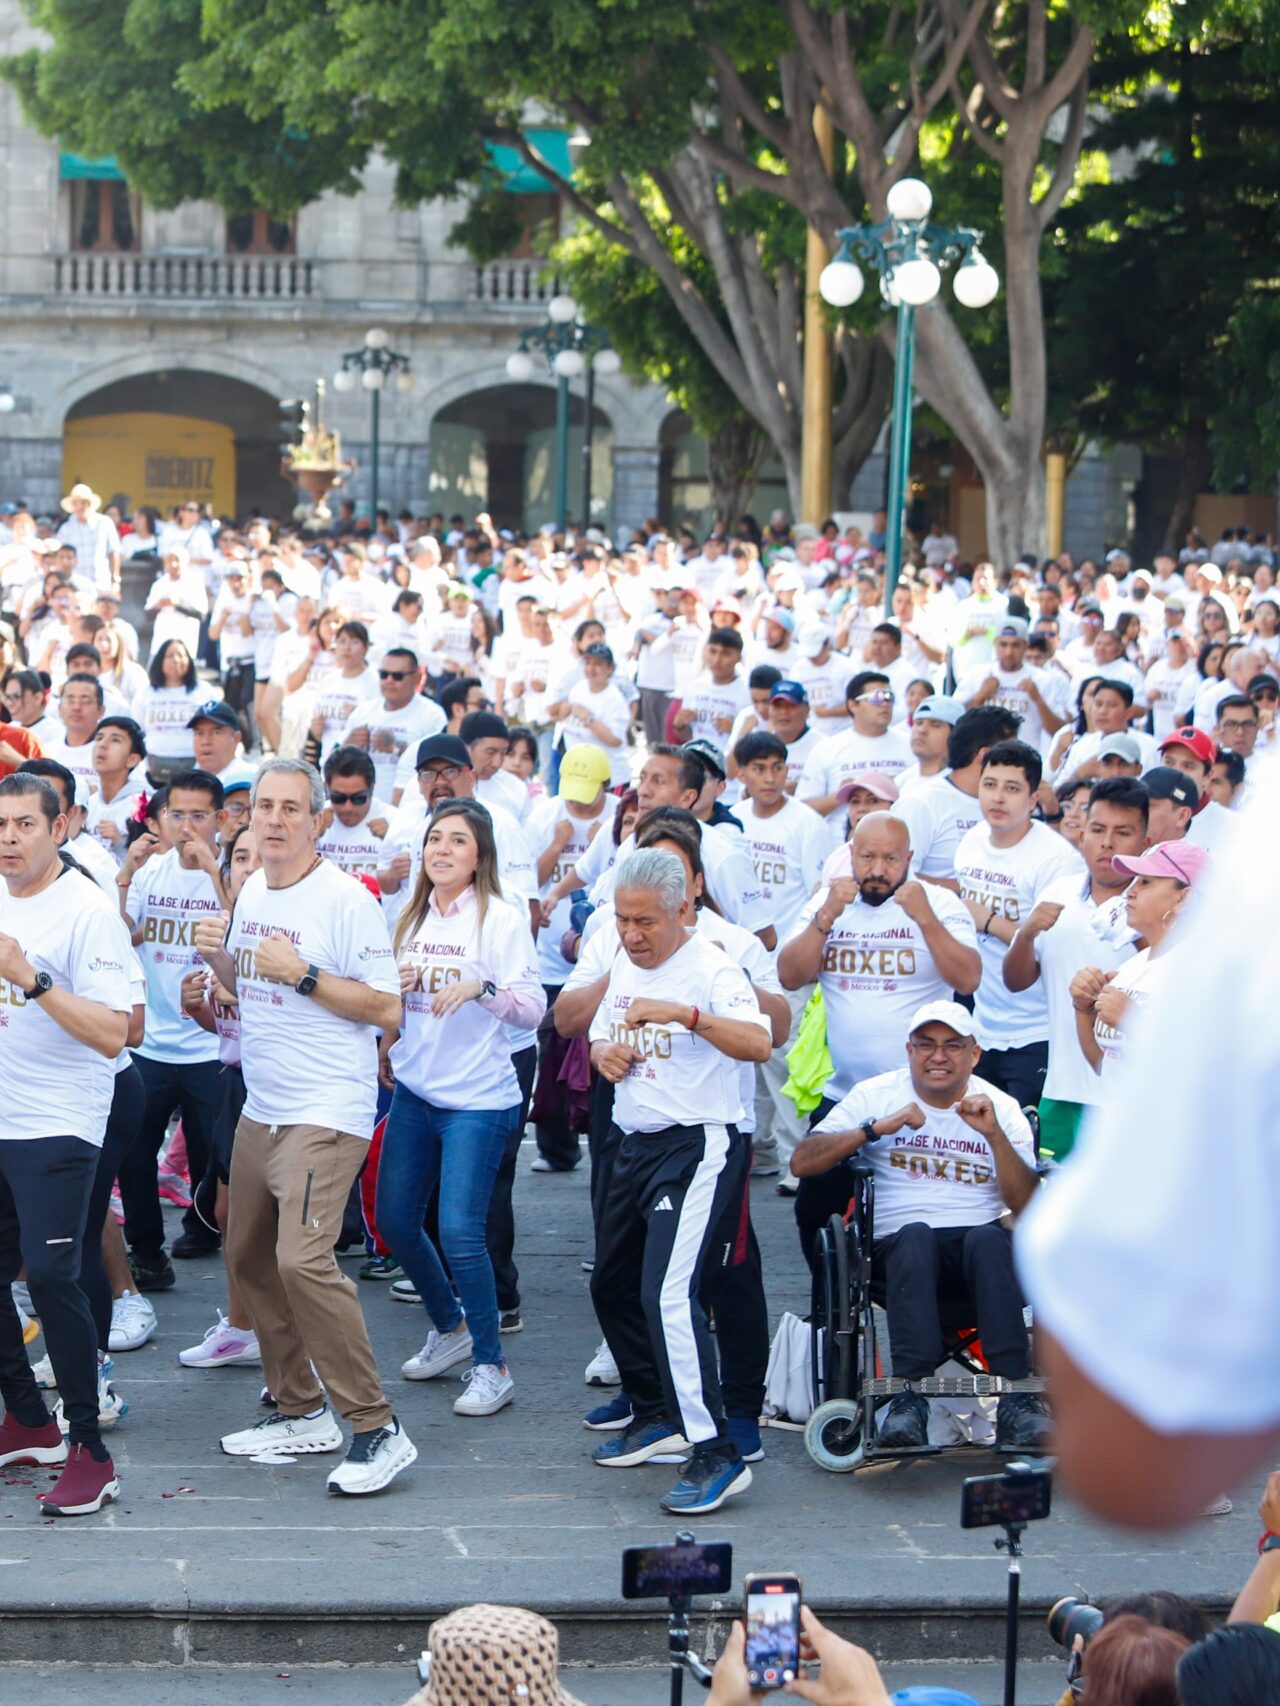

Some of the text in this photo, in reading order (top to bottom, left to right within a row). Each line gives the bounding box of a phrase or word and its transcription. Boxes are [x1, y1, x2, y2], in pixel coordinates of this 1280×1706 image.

[753, 860, 786, 884] XEO
[148, 894, 178, 908] CLASE
[144, 917, 202, 946] BOXE
[422, 943, 467, 957] NACIONAL
[823, 947, 916, 976] BOXEO
[413, 965, 461, 994] XEO
[851, 982, 880, 992] México
[614, 995, 631, 1009] LASE
[932, 1136, 989, 1155] NACIONAL
[890, 1152, 992, 1184] BOXEO
